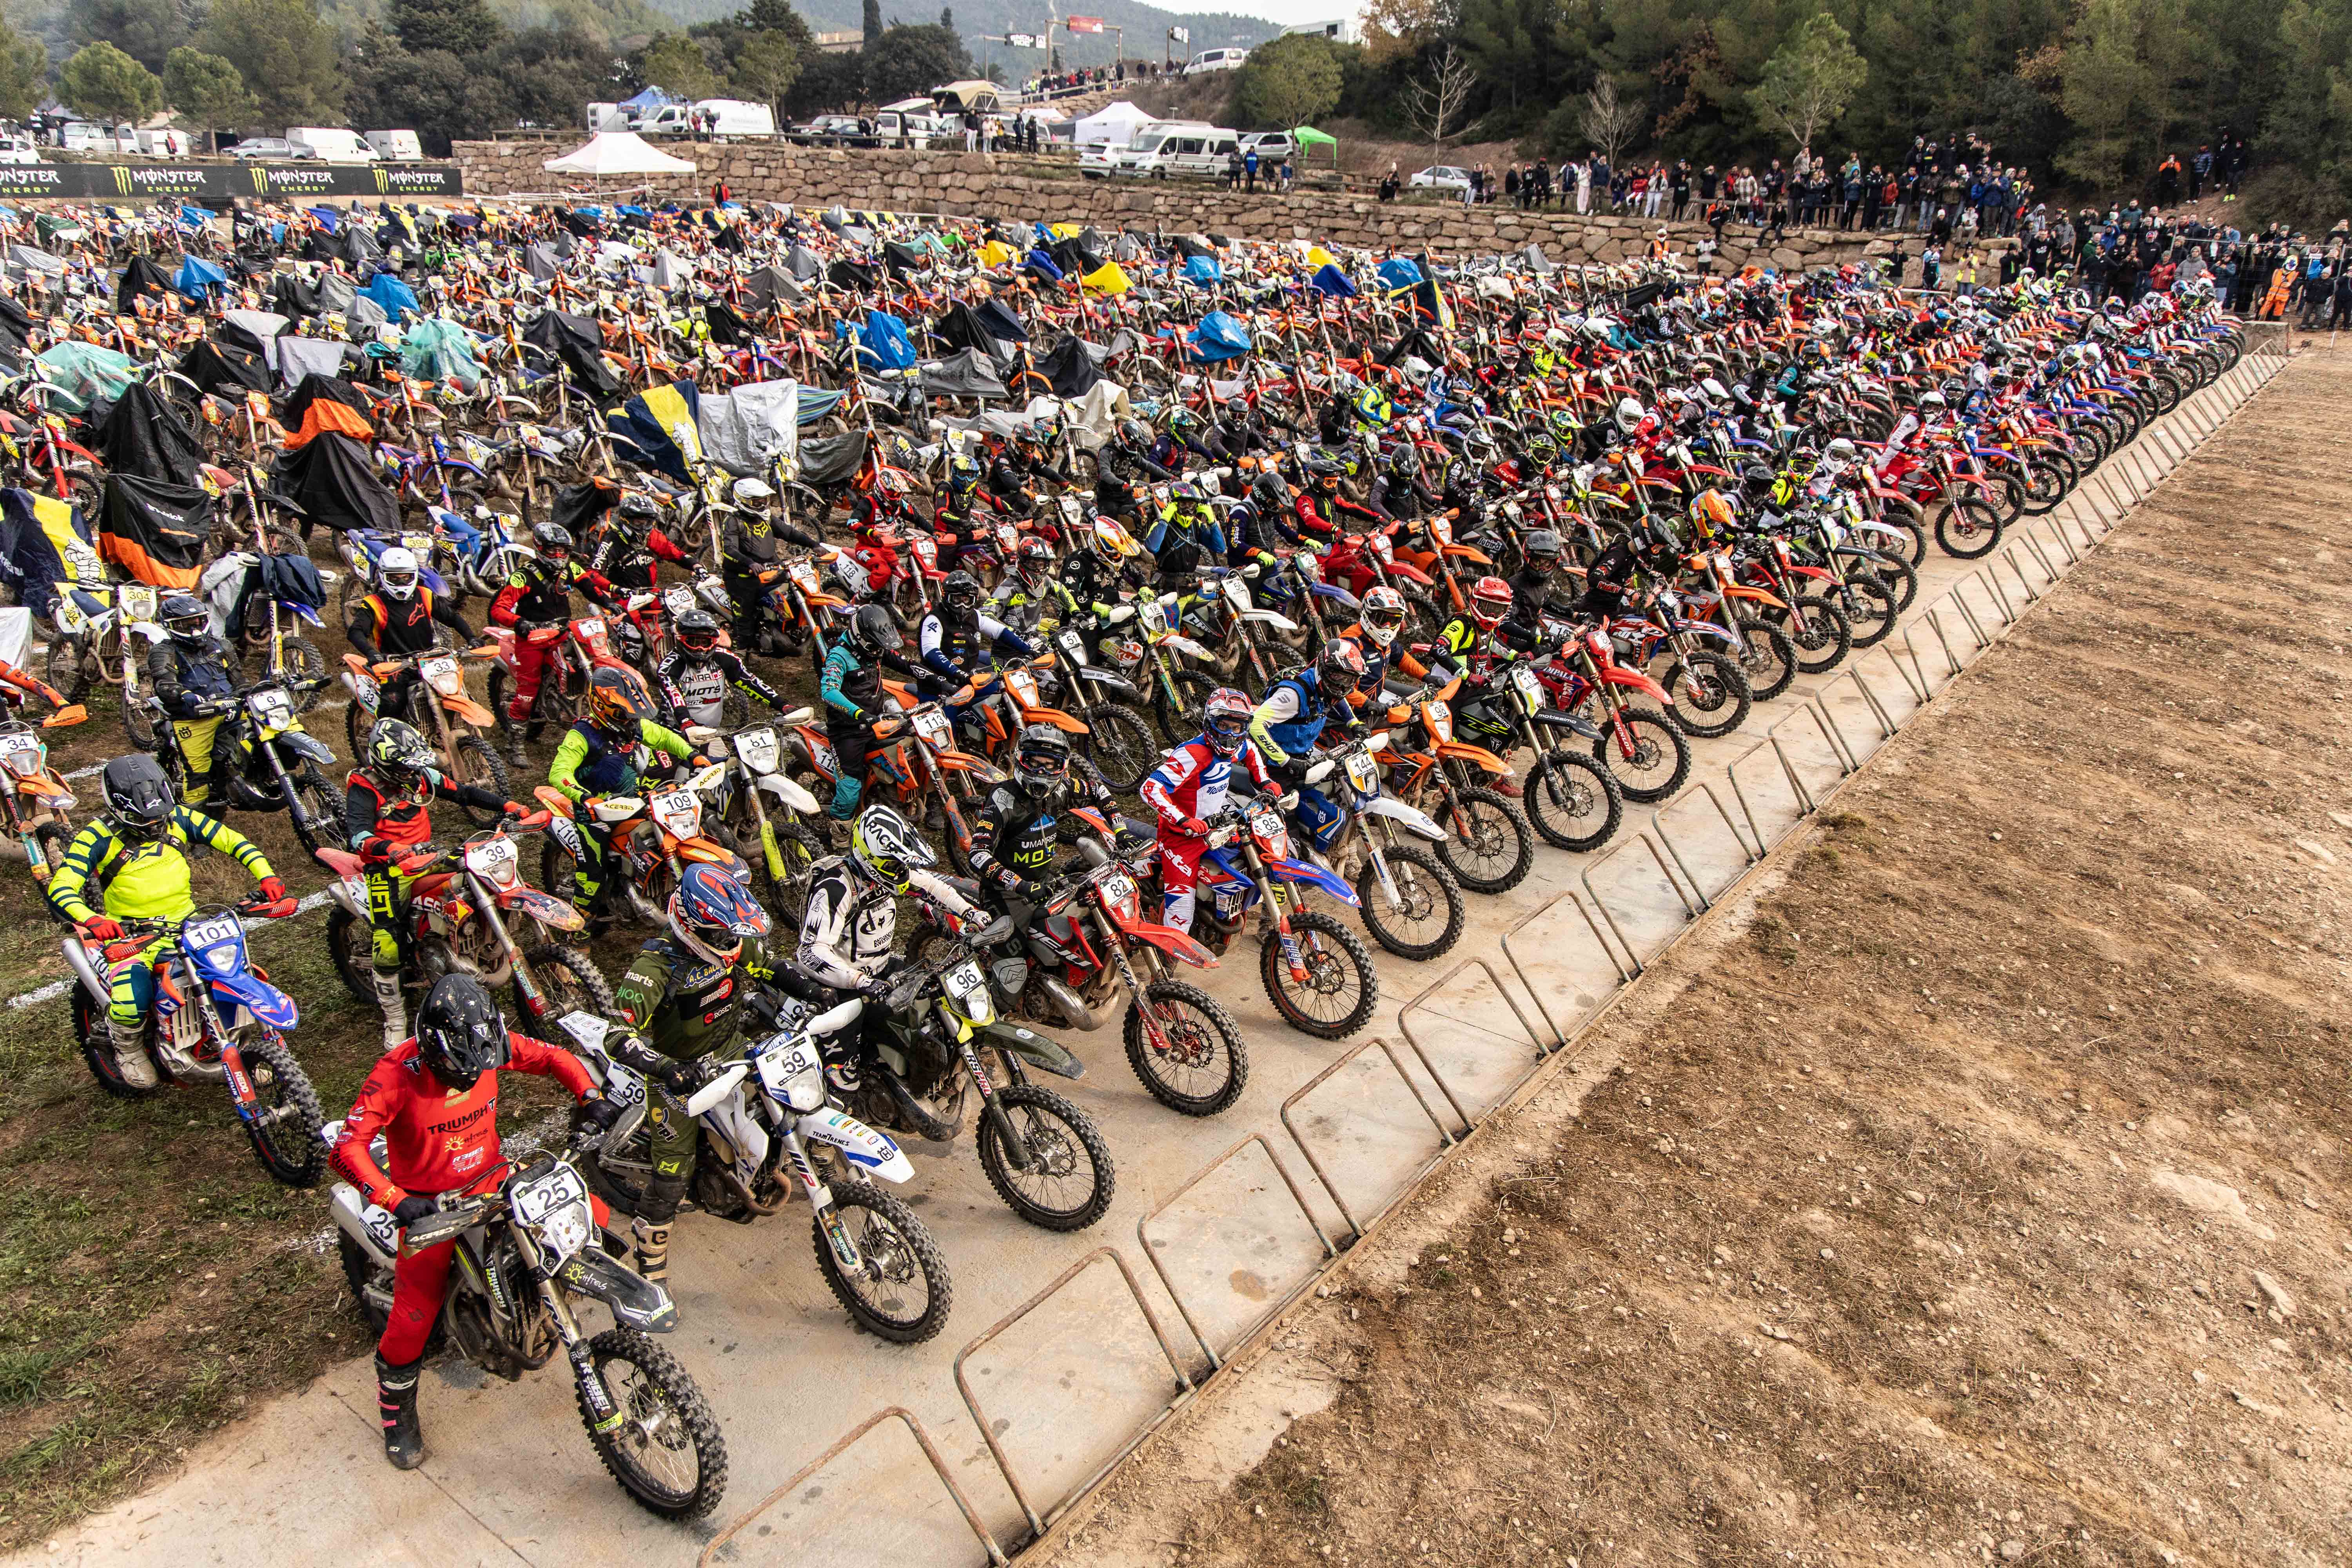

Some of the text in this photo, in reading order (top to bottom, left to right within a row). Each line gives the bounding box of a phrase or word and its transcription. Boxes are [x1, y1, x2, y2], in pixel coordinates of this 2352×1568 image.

[0, 167, 61, 184] ONSTER
[133, 169, 207, 184] MONSTER
[269, 170, 335, 184] MONSTER
[389, 171, 445, 184] MONSTER
[1379, 537, 1389, 545] 72
[920, 544, 935, 553] 118
[356, 556, 367, 569] 390
[800, 566, 811, 575] 55
[843, 564, 856, 577] 118
[1234, 583, 1243, 591] 56
[129, 592, 150, 600] 304
[671, 592, 690, 603] 120
[66, 607, 78, 623] 304
[588, 622, 600, 632] 17
[1067, 635, 1079, 645] 51
[434, 661, 450, 672] 33
[1021, 675, 1025, 683] 7
[267, 696, 276, 705] 9
[363, 690, 374, 703] 33
[1434, 706, 1446, 716] 98
[1486, 705, 1511, 728] motissimo
[924, 715, 945, 729] 113
[1538, 713, 1577, 724] motissimo
[7, 737, 29, 750] 34
[1614, 721, 1631, 753] DUNLOP
[1257, 735, 1279, 753] SHOT
[1354, 757, 1372, 772] 144
[699, 767, 722, 788] ACERBIS
[665, 795, 692, 811] 109
[1262, 817, 1278, 831] 85
[485, 845, 506, 862] 39
[904, 856, 929, 865] Airoh
[1003, 871, 1015, 883] 108
[1110, 880, 1128, 897] 82
[195, 923, 233, 943] 101
[730, 923, 757, 934] Airoh
[1174, 952, 1194, 963] RIEJU
[956, 969, 978, 989] 96
[714, 1004, 732, 1017] ROSET
[563, 1021, 582, 1035] DUNLOP
[781, 1051, 806, 1074] 59
[222, 1064, 238, 1097] MICHELIN
[622, 1082, 645, 1105] 59
[427, 1104, 488, 1135] TRIUMPH
[457, 1161, 482, 1172] TYRES
[537, 1181, 569, 1210] 25
[370, 1211, 395, 1240] 25
[837, 1236, 853, 1263] MOTOREX
[490, 1266, 506, 1308] TRIUMPH
[569, 1283, 586, 1294] LIVING
